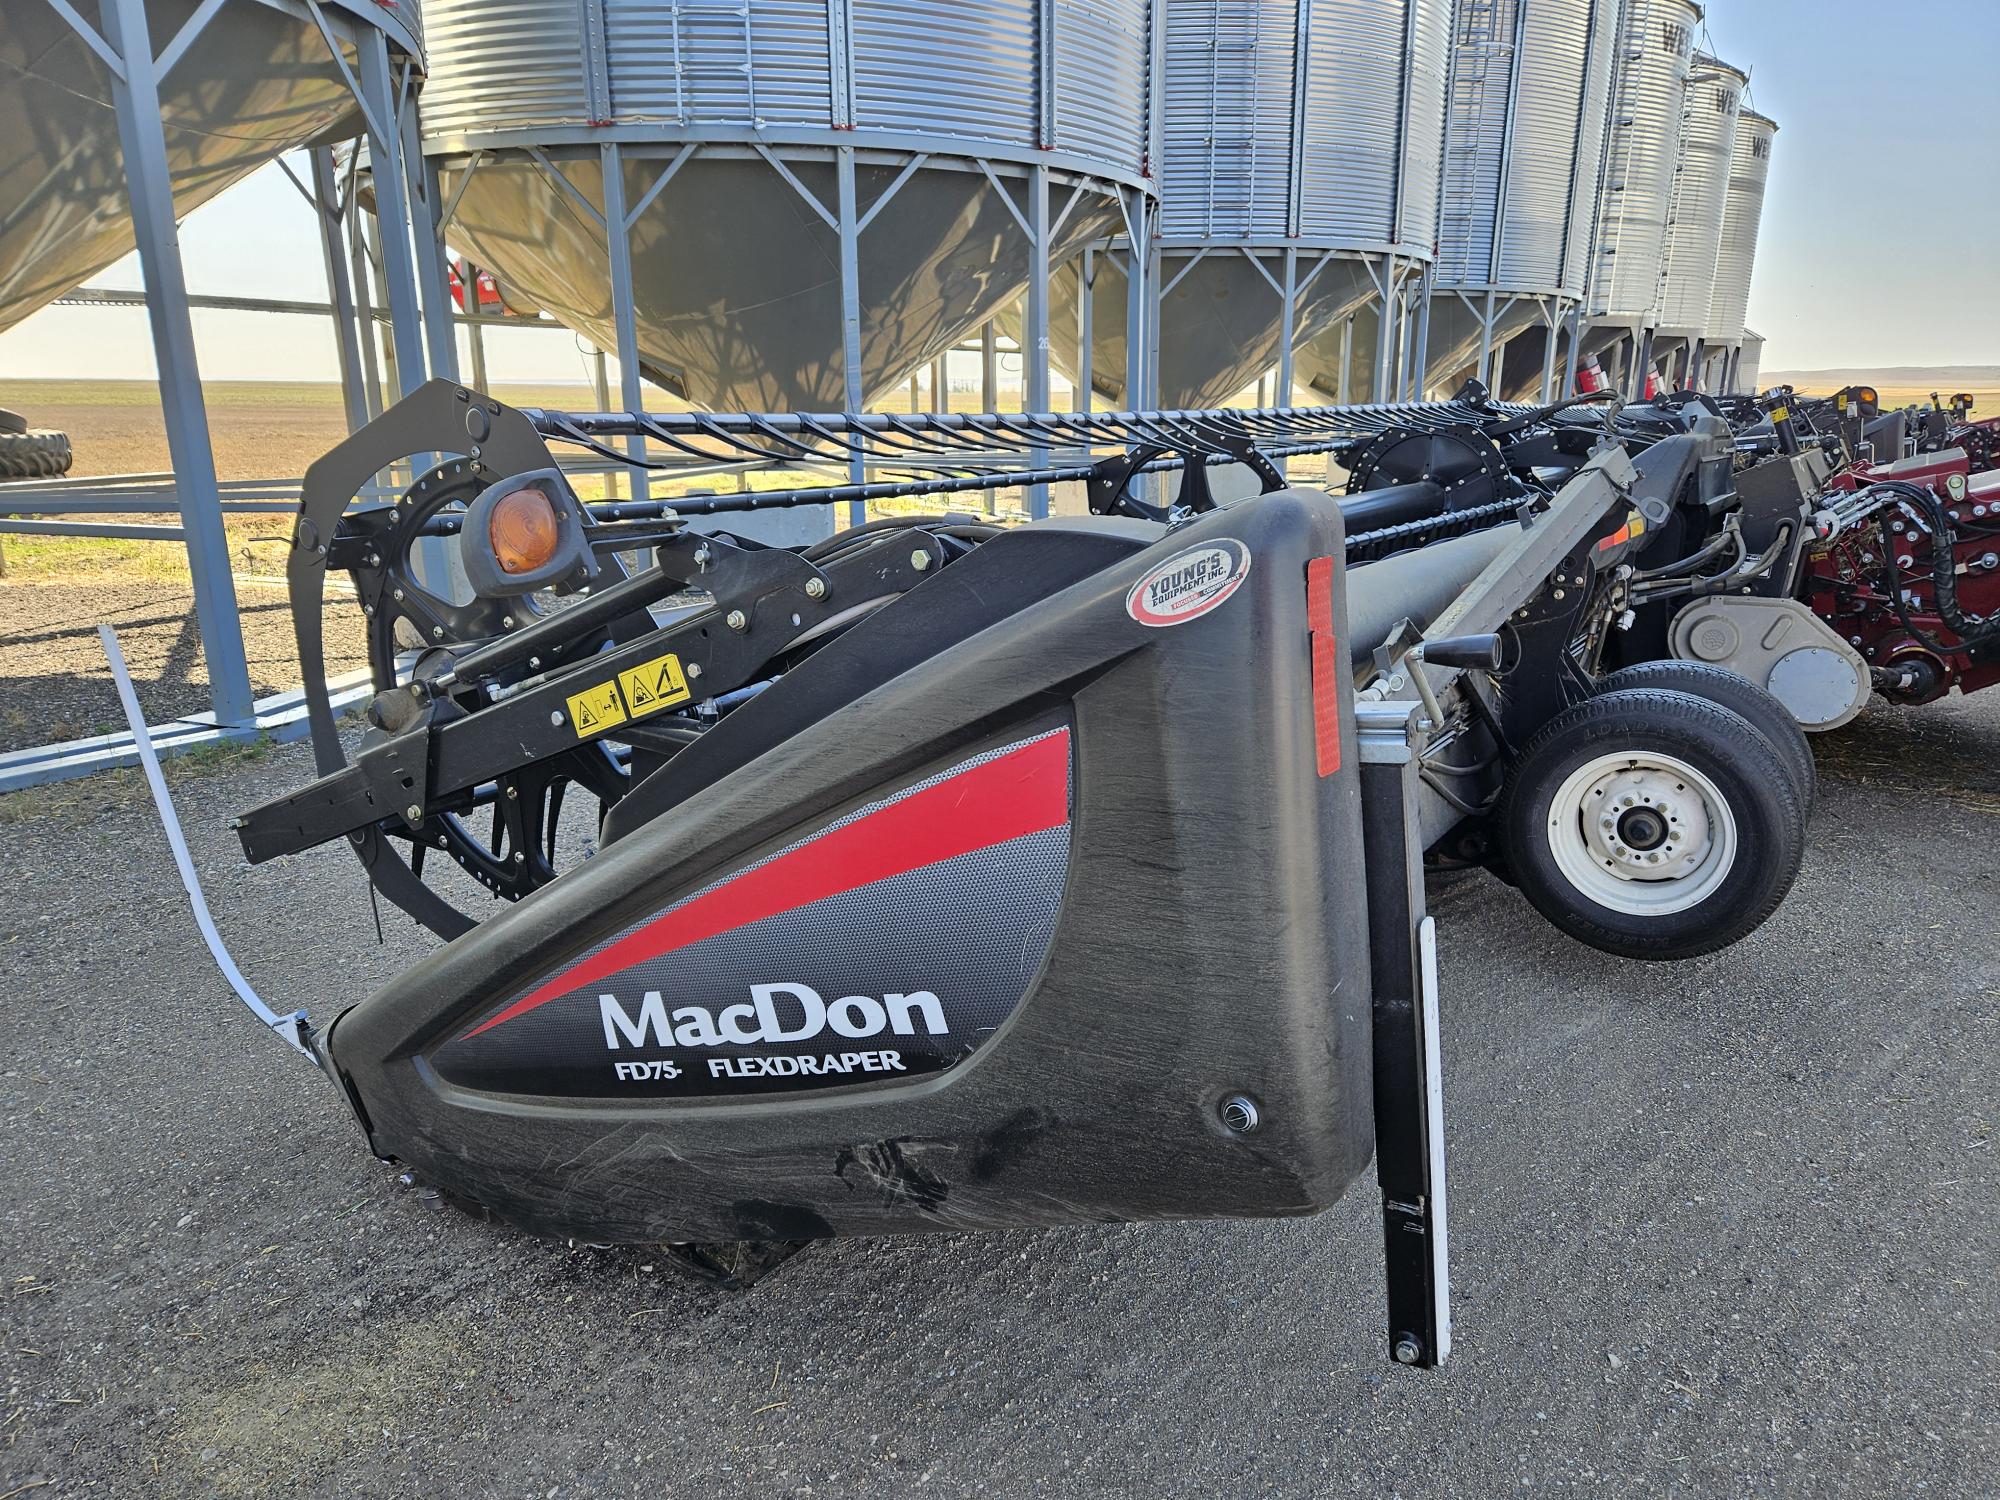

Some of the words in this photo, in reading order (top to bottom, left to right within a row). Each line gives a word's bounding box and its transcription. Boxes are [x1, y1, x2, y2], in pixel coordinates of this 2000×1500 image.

[1149, 551, 1221, 599] YOUNG'S
[1152, 575, 1206, 607] EQUIPMENT
[1207, 566, 1227, 581] INC.
[599, 982, 949, 1050] MacDon
[707, 1050, 906, 1078] FLEXDRAPER
